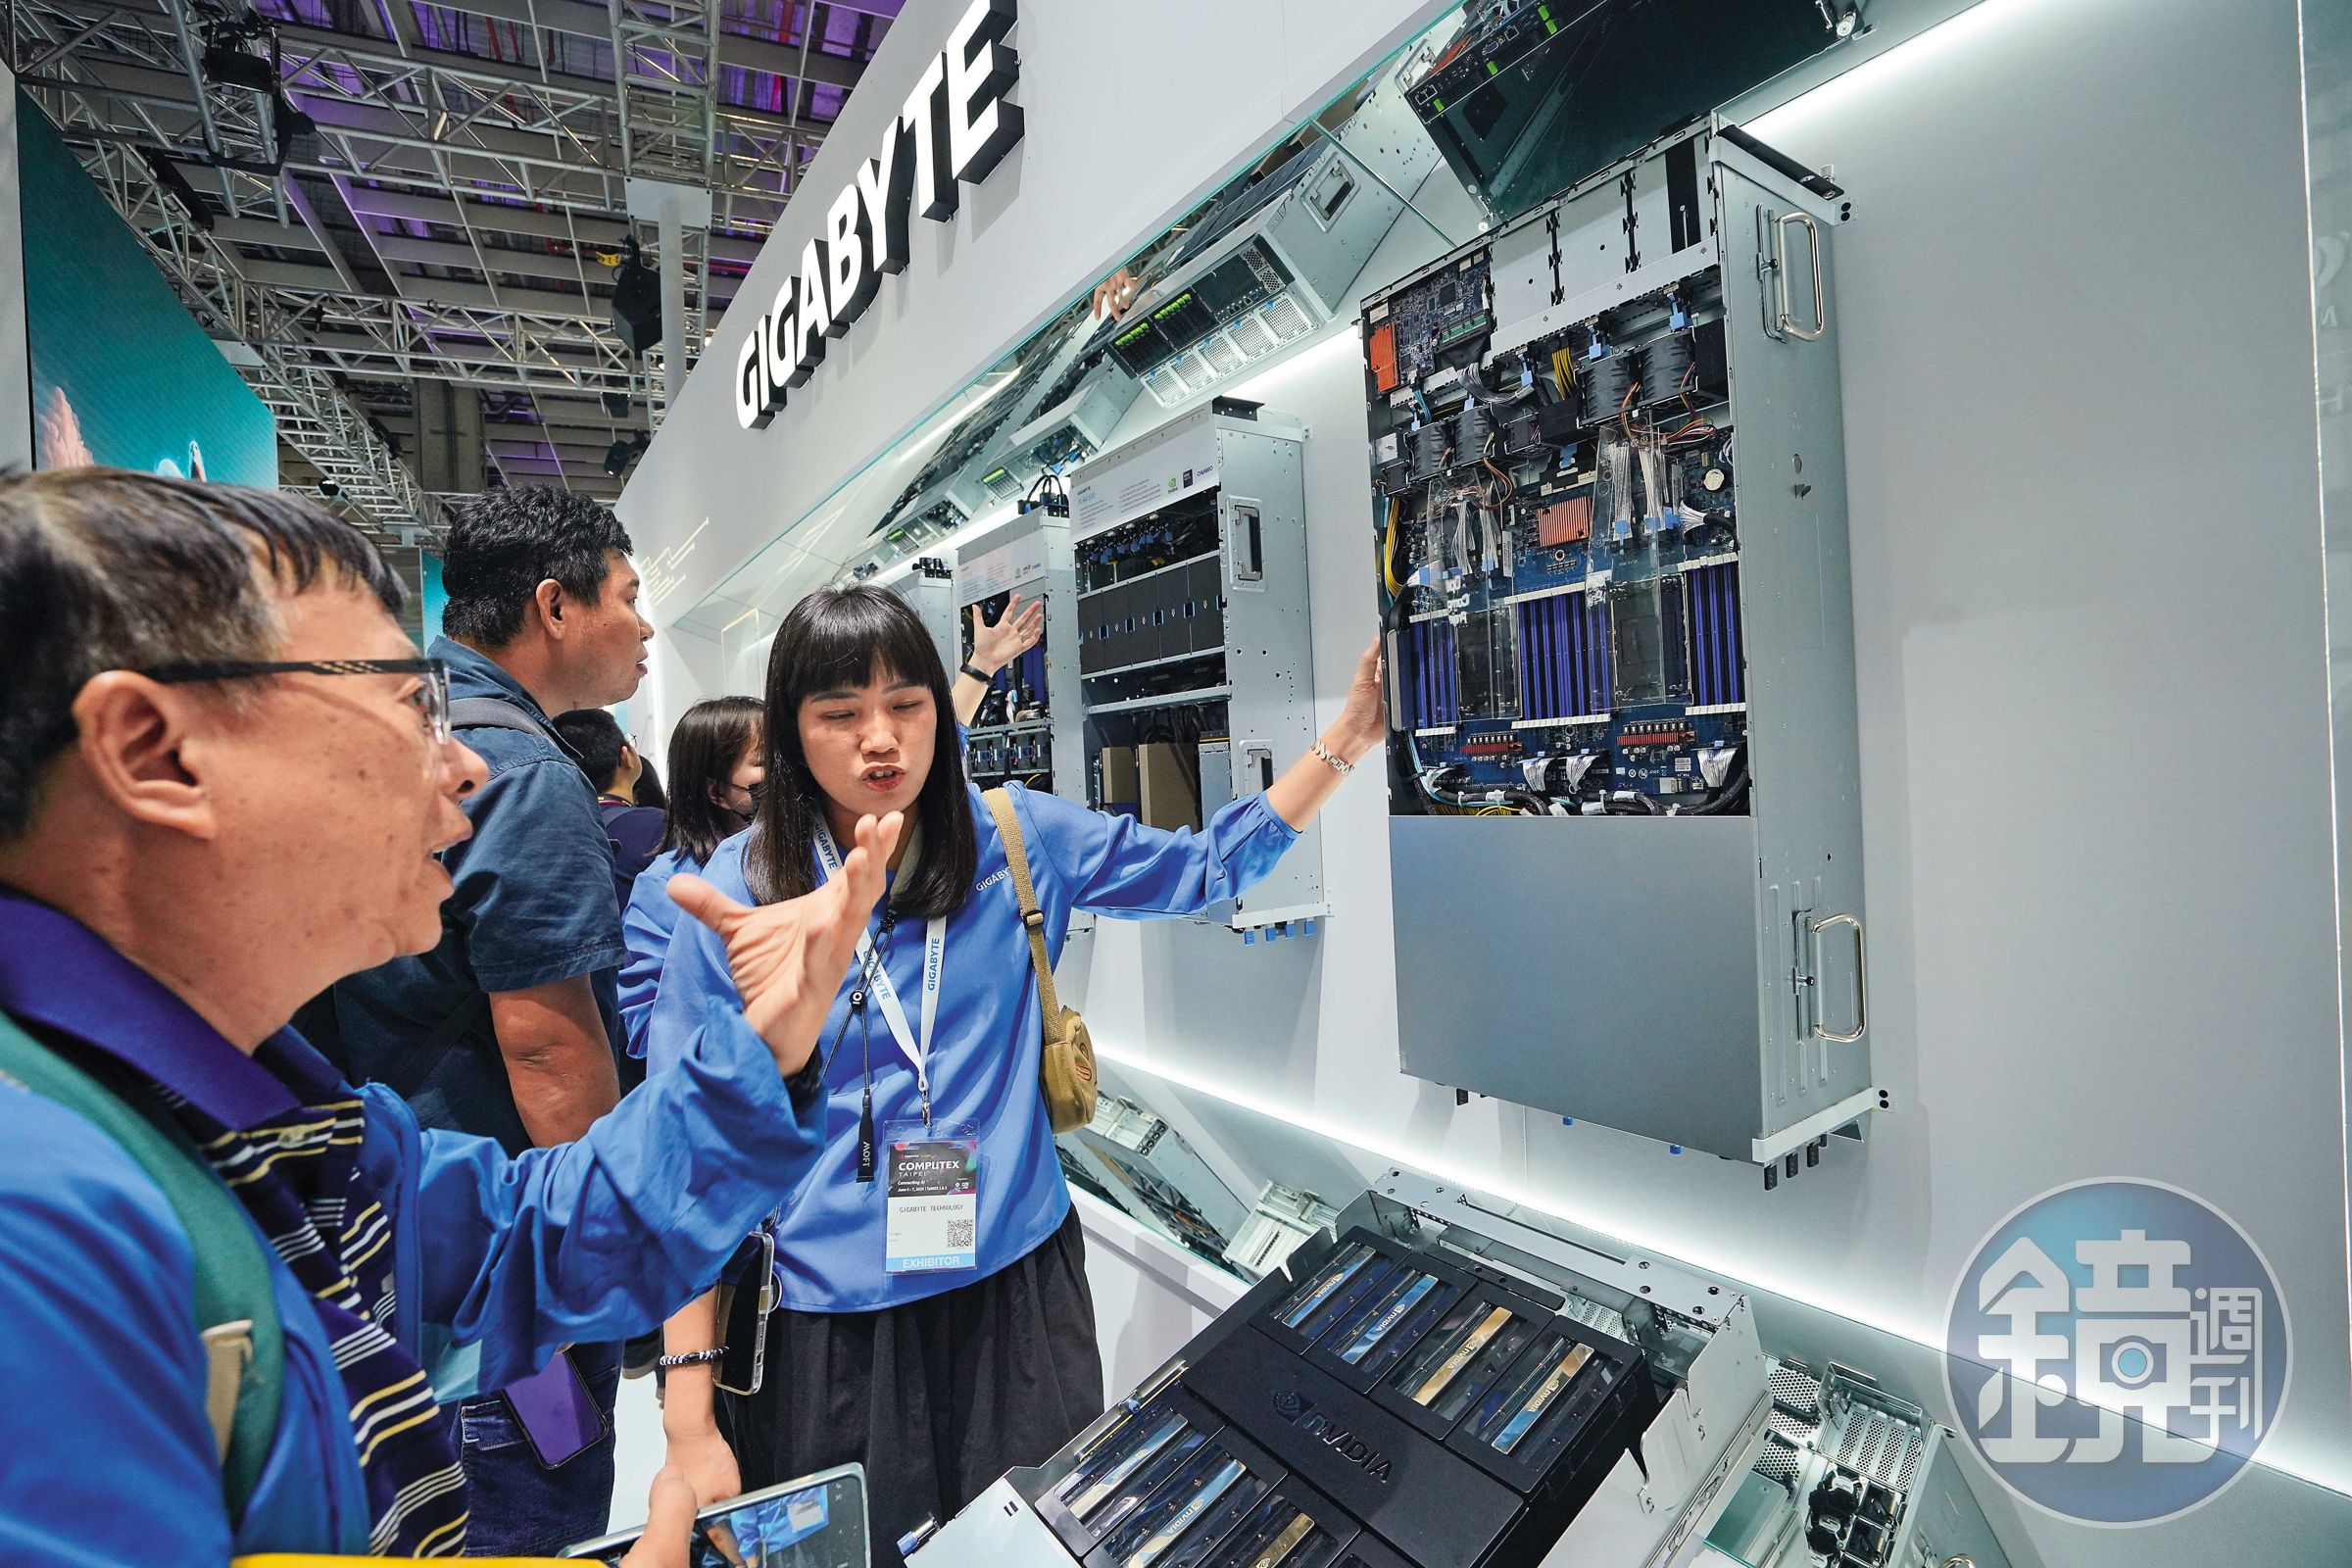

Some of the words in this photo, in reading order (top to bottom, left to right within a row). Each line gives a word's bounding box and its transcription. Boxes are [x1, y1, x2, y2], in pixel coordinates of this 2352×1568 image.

[736, 0, 1011, 429] GIGABYTE
[814, 823, 838, 869] GIGABYTE
[976, 865, 1010, 891] GIGABY
[927, 937, 941, 992] GIGABYTE
[862, 1141, 871, 1168] MOFT
[898, 1160, 960, 1171] COMPUTEX
[903, 1255, 960, 1269] EXHIBITOR
